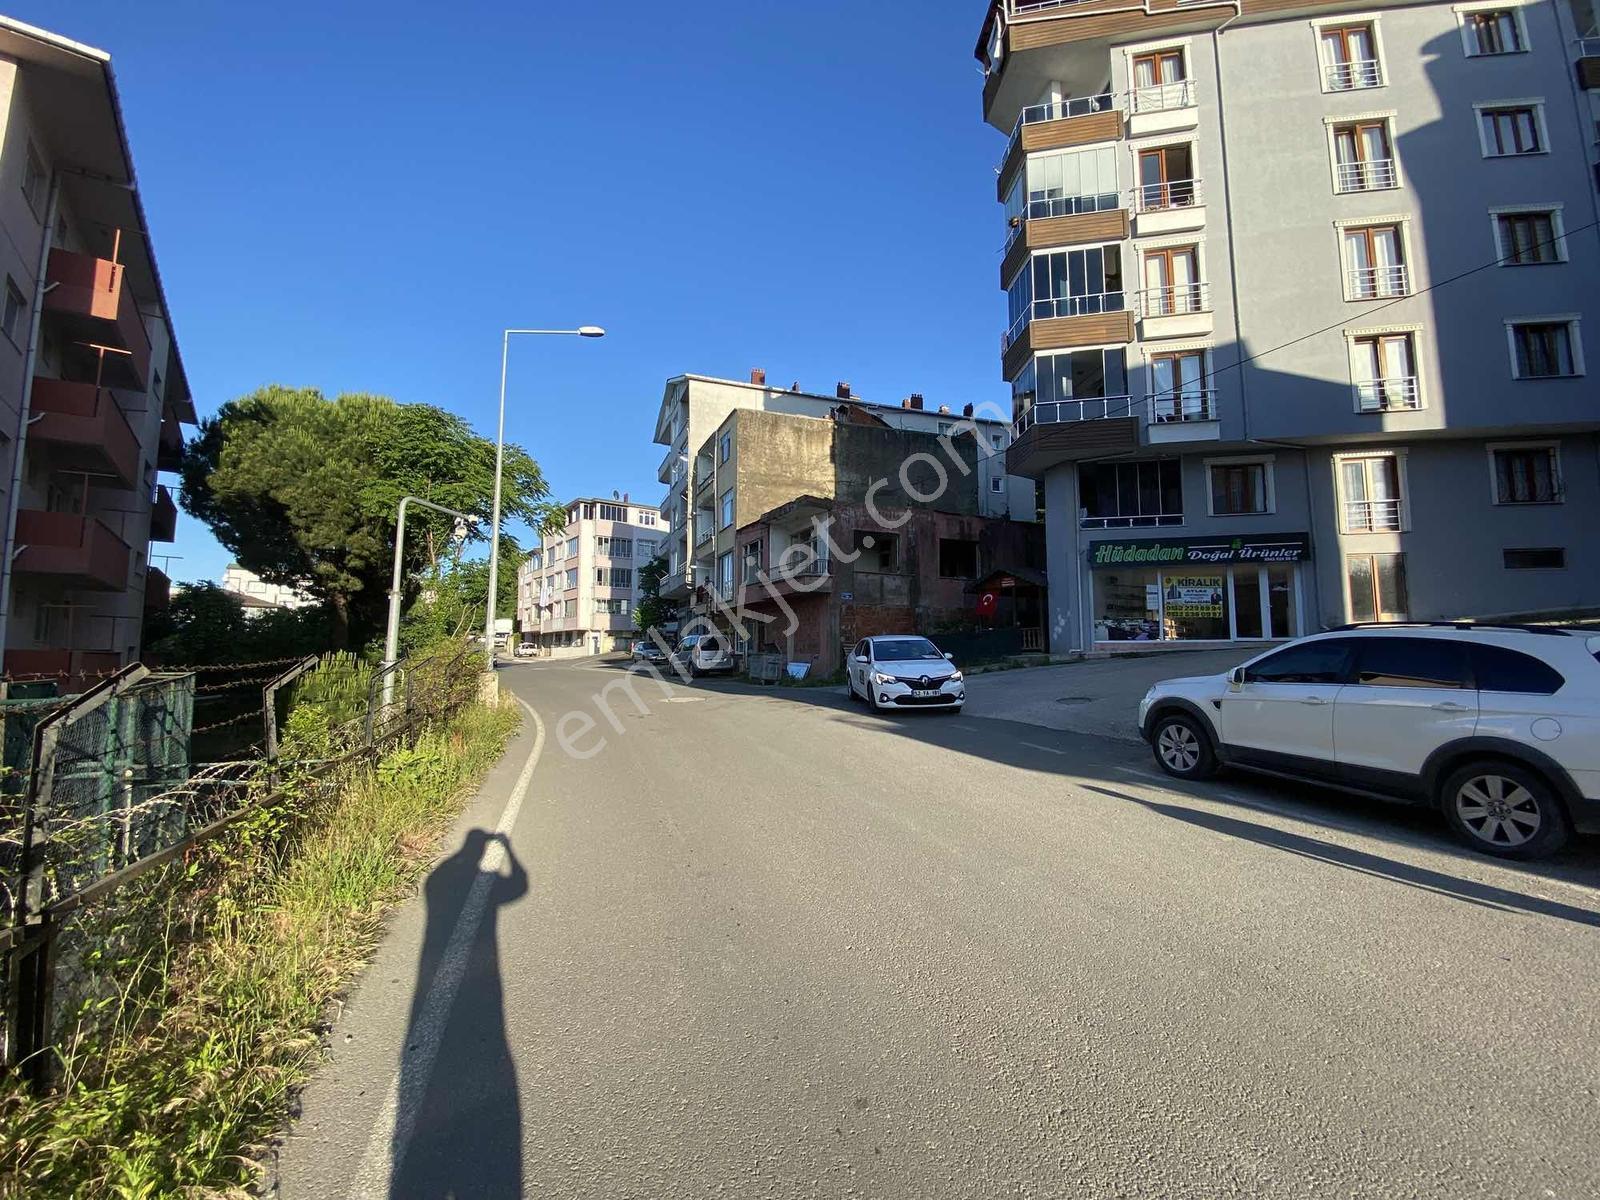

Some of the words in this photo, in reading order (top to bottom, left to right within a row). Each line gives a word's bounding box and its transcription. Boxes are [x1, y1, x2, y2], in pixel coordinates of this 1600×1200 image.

[1095, 544, 1184, 563] Hüdadan
[1187, 550, 1234, 561] Doğal
[1239, 547, 1302, 558] Ürünler
[1178, 577, 1220, 587] KİRALIK
